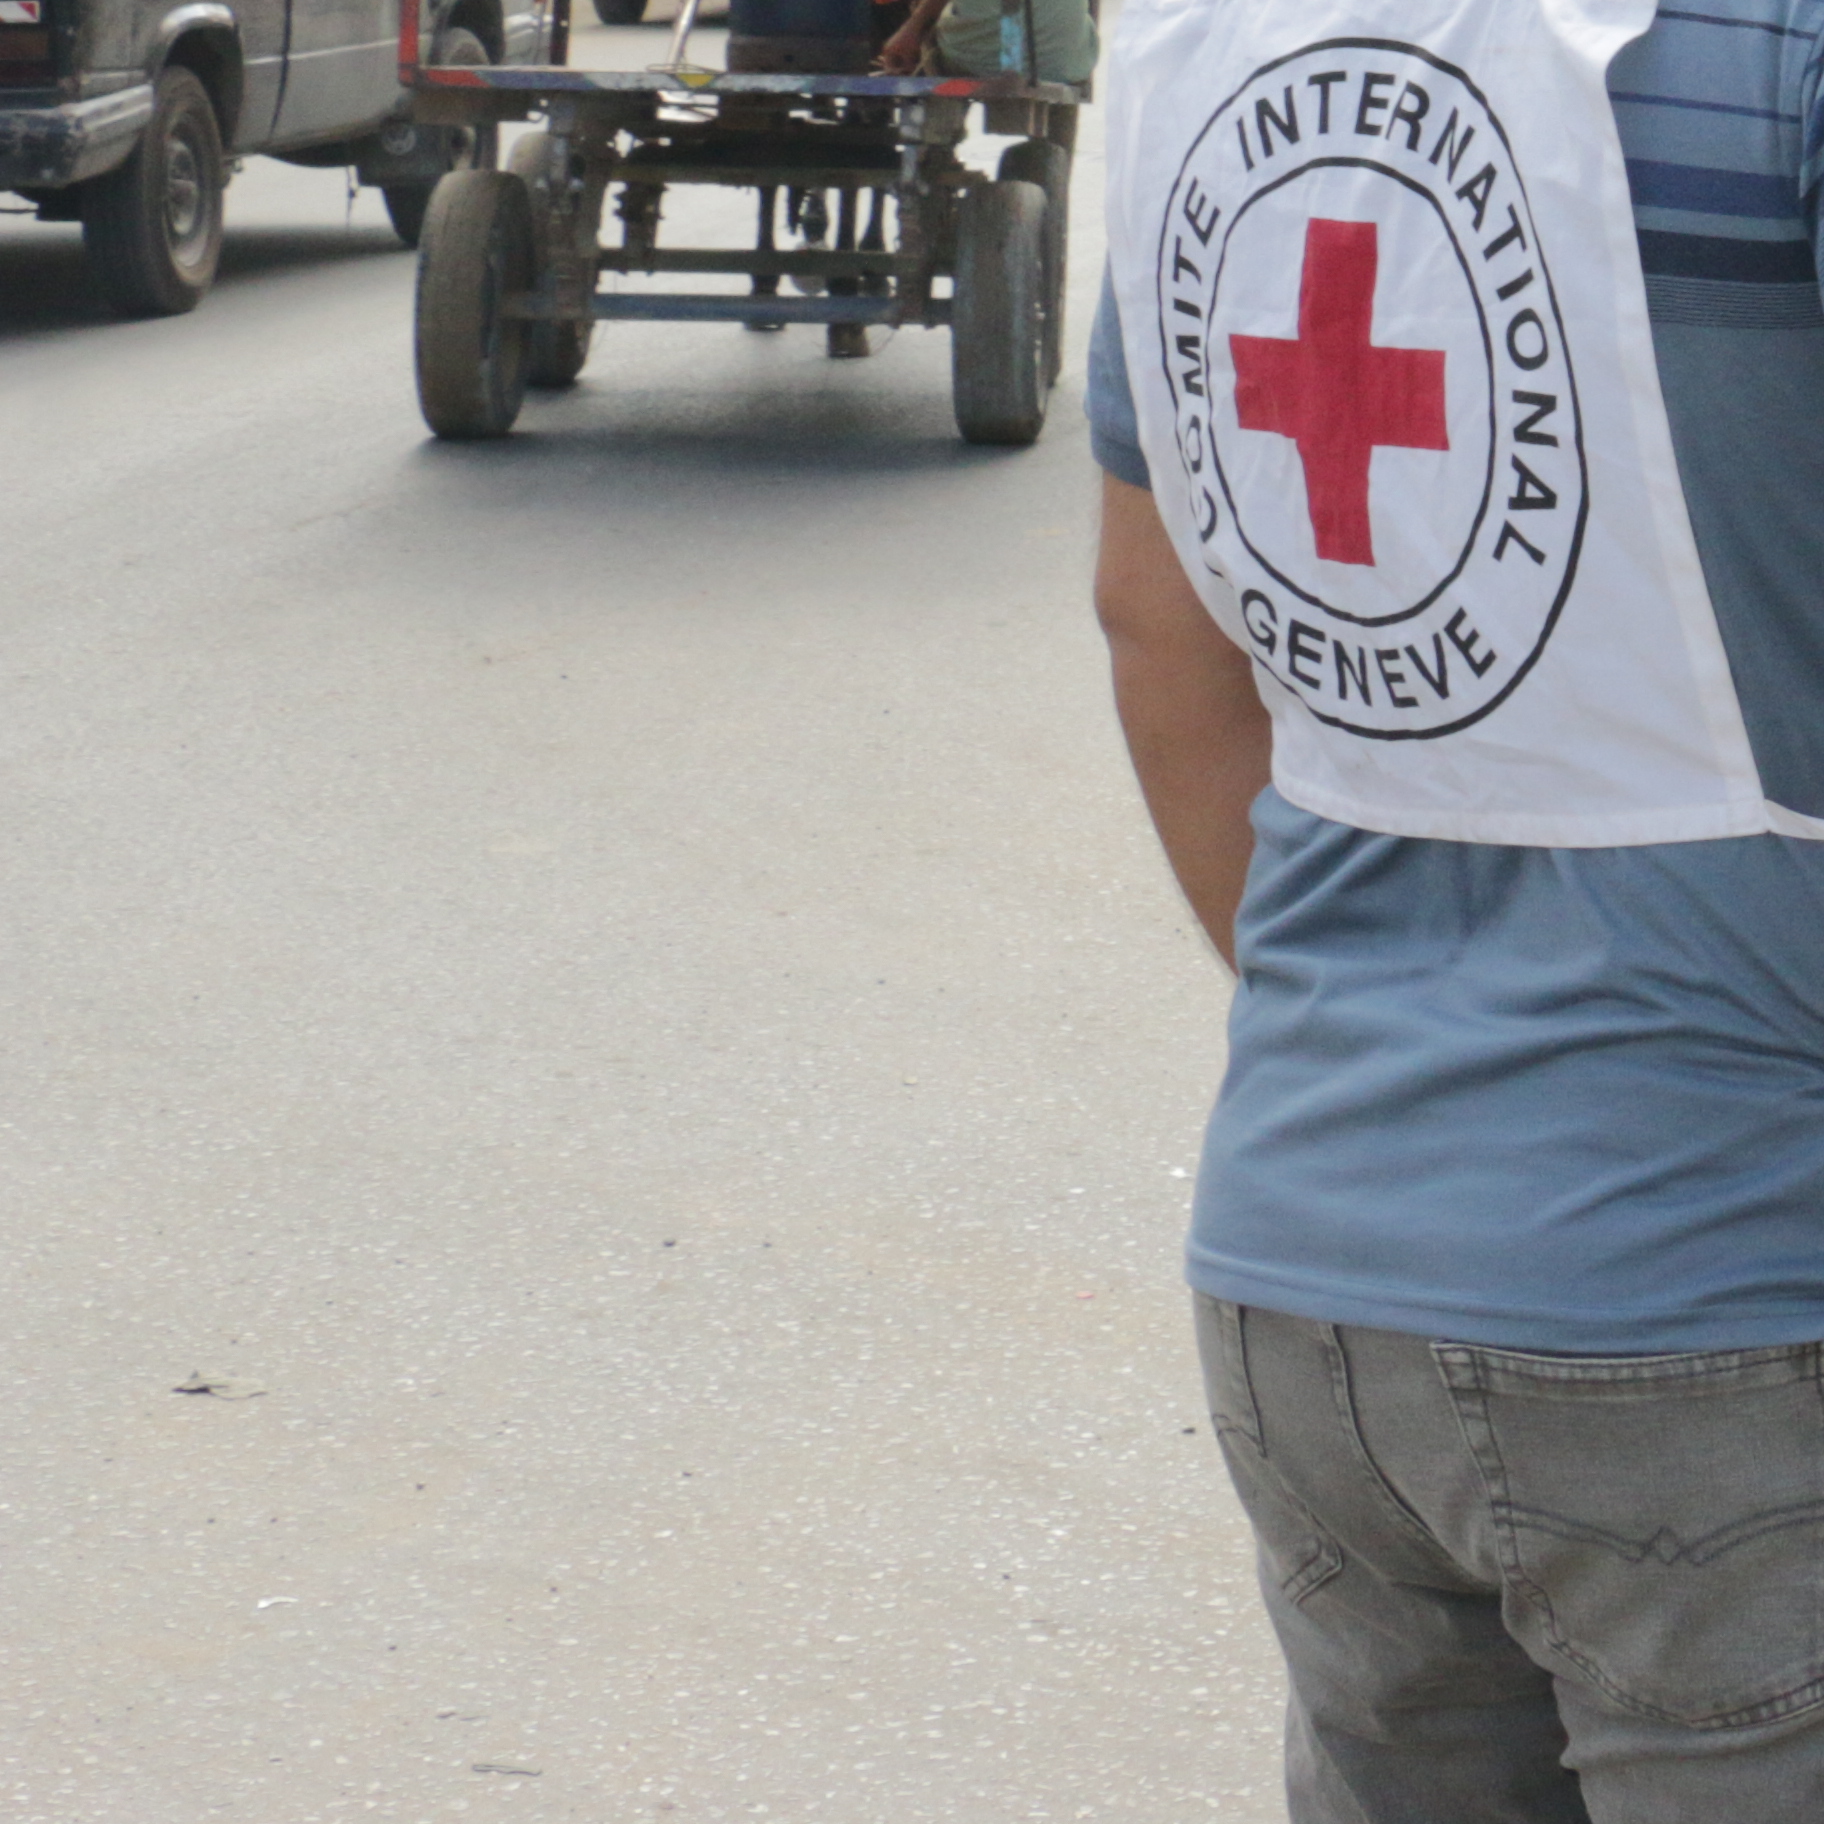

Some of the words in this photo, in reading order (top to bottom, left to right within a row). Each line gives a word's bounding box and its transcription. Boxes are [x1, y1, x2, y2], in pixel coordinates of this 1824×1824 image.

[1173, 176, 1220, 545] COMITE
[1236, 71, 1559, 565] INTERNATIONAL
[1241, 589, 1496, 708] GENEVE
